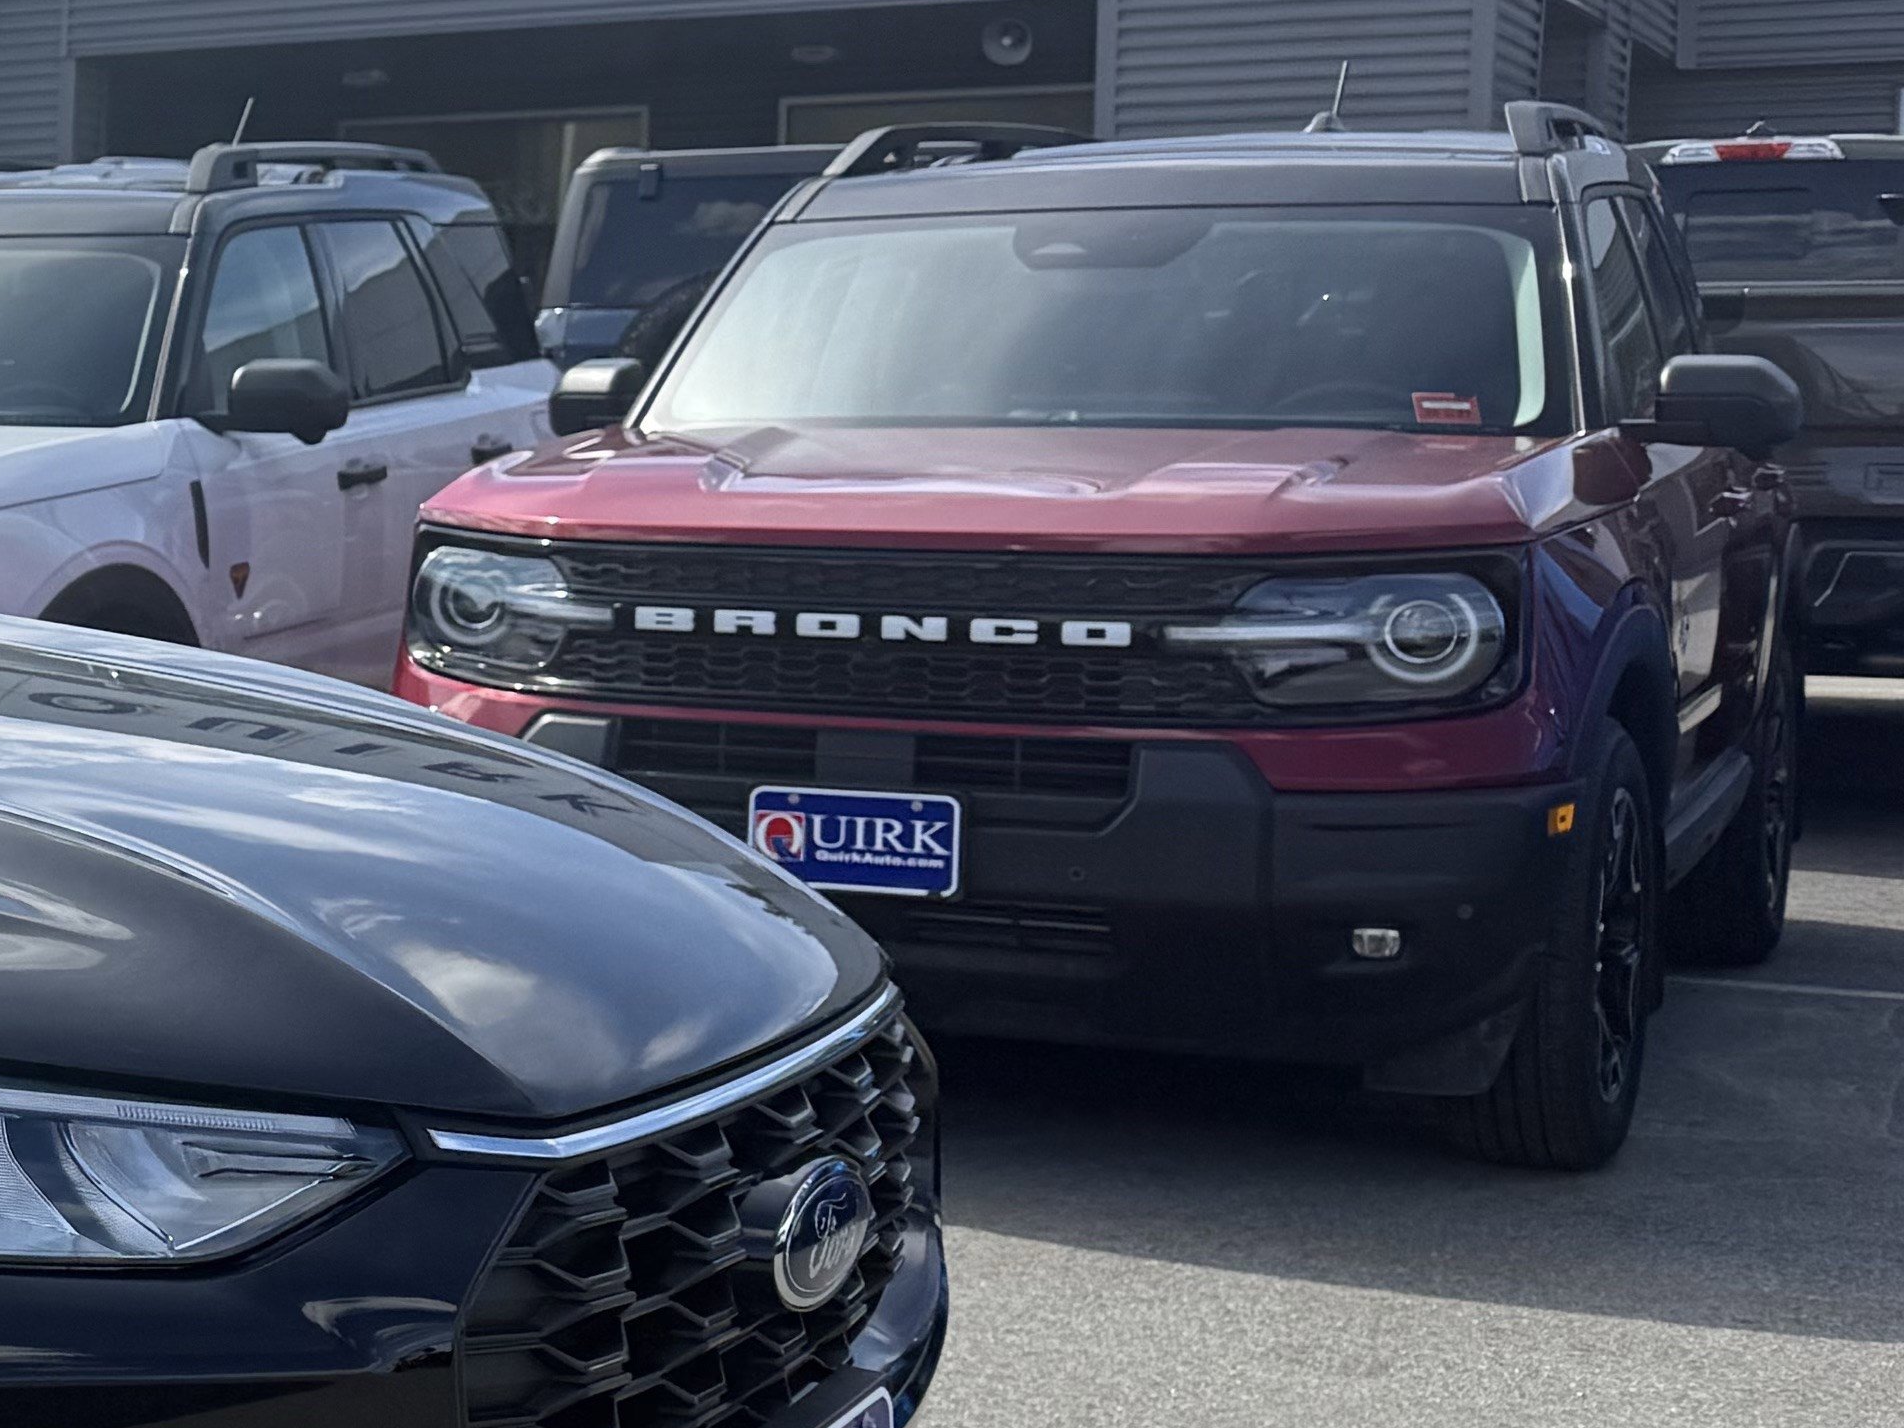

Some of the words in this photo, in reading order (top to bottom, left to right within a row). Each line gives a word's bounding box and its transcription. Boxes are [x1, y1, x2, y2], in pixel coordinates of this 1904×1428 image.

[634, 605, 1132, 647] BRONCO
[755, 813, 952, 861] QUIRK
[814, 849, 945, 869] QuirkAuto.com
